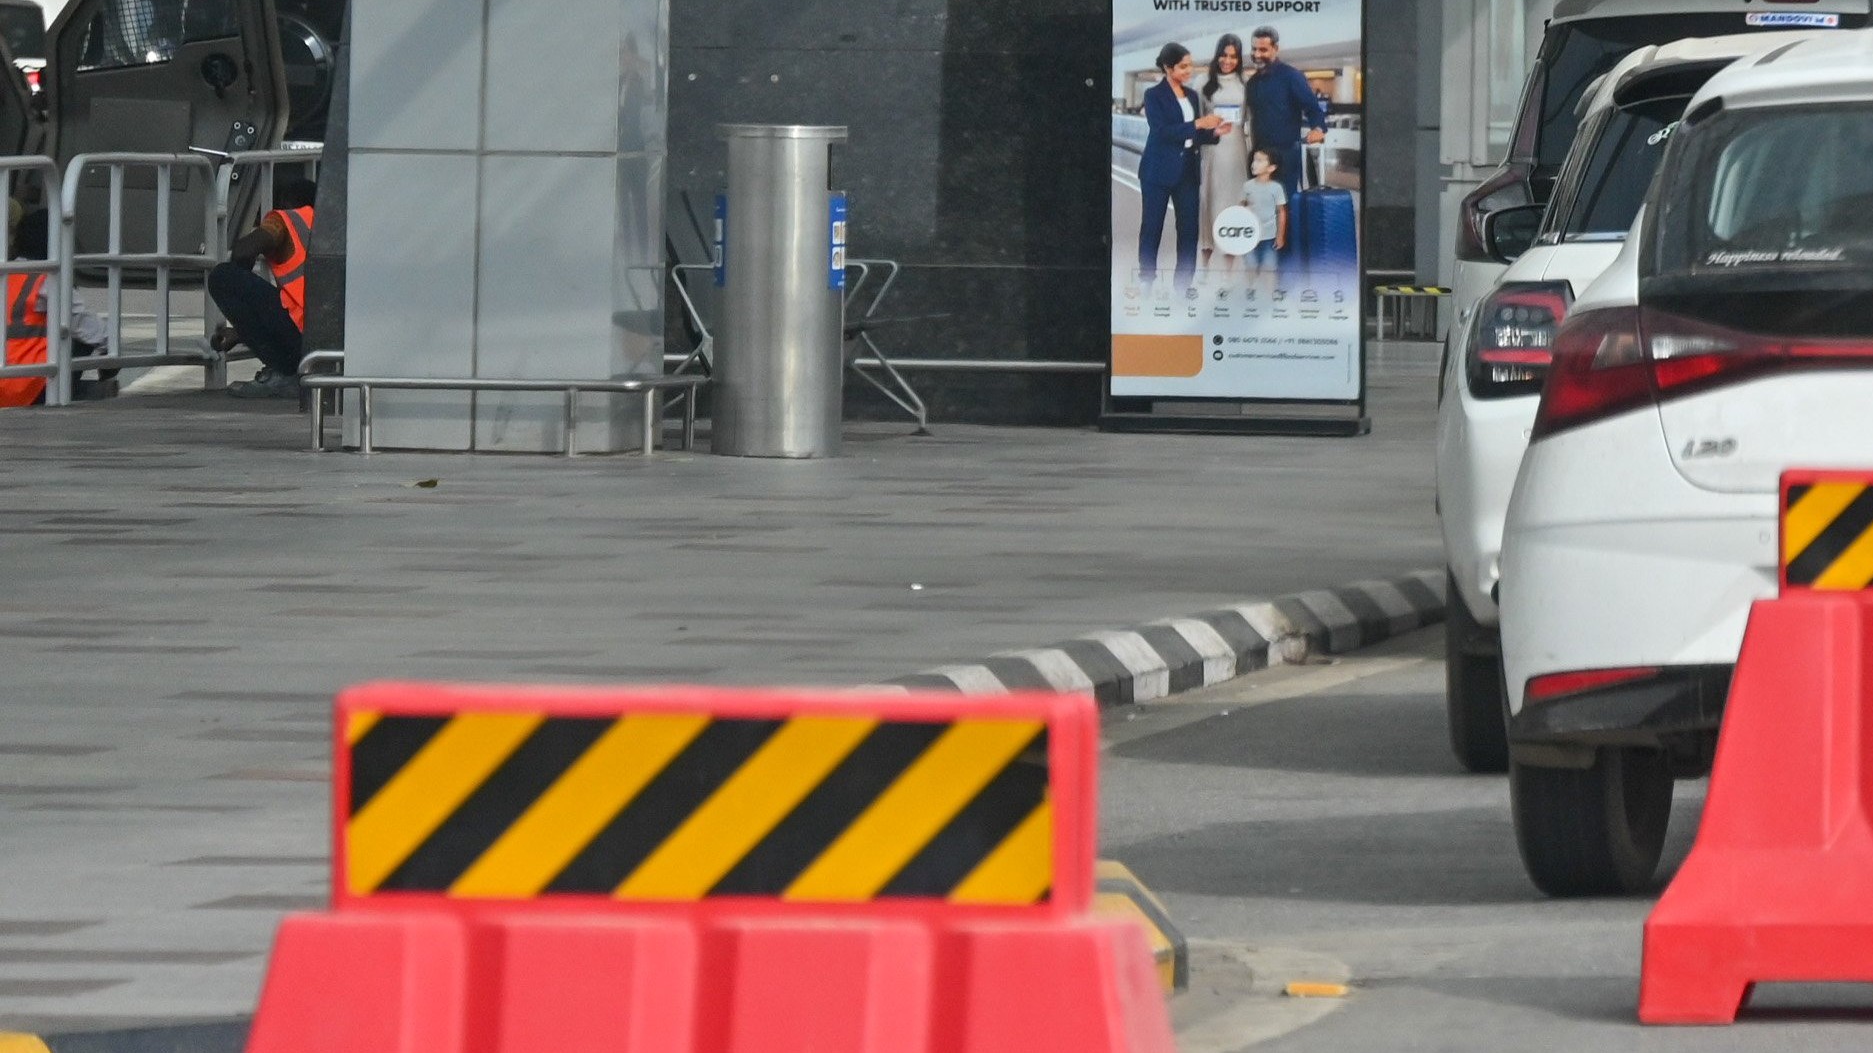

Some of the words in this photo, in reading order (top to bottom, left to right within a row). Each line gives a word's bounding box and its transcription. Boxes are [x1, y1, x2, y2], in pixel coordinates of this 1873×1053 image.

[1153, 0, 1190, 11] WITH
[1194, 0, 1252, 12] TRUSTED
[1257, 0, 1321, 12] SUPPORT
[1218, 226, 1254, 238] care
[1705, 249, 1779, 267] Happiness
